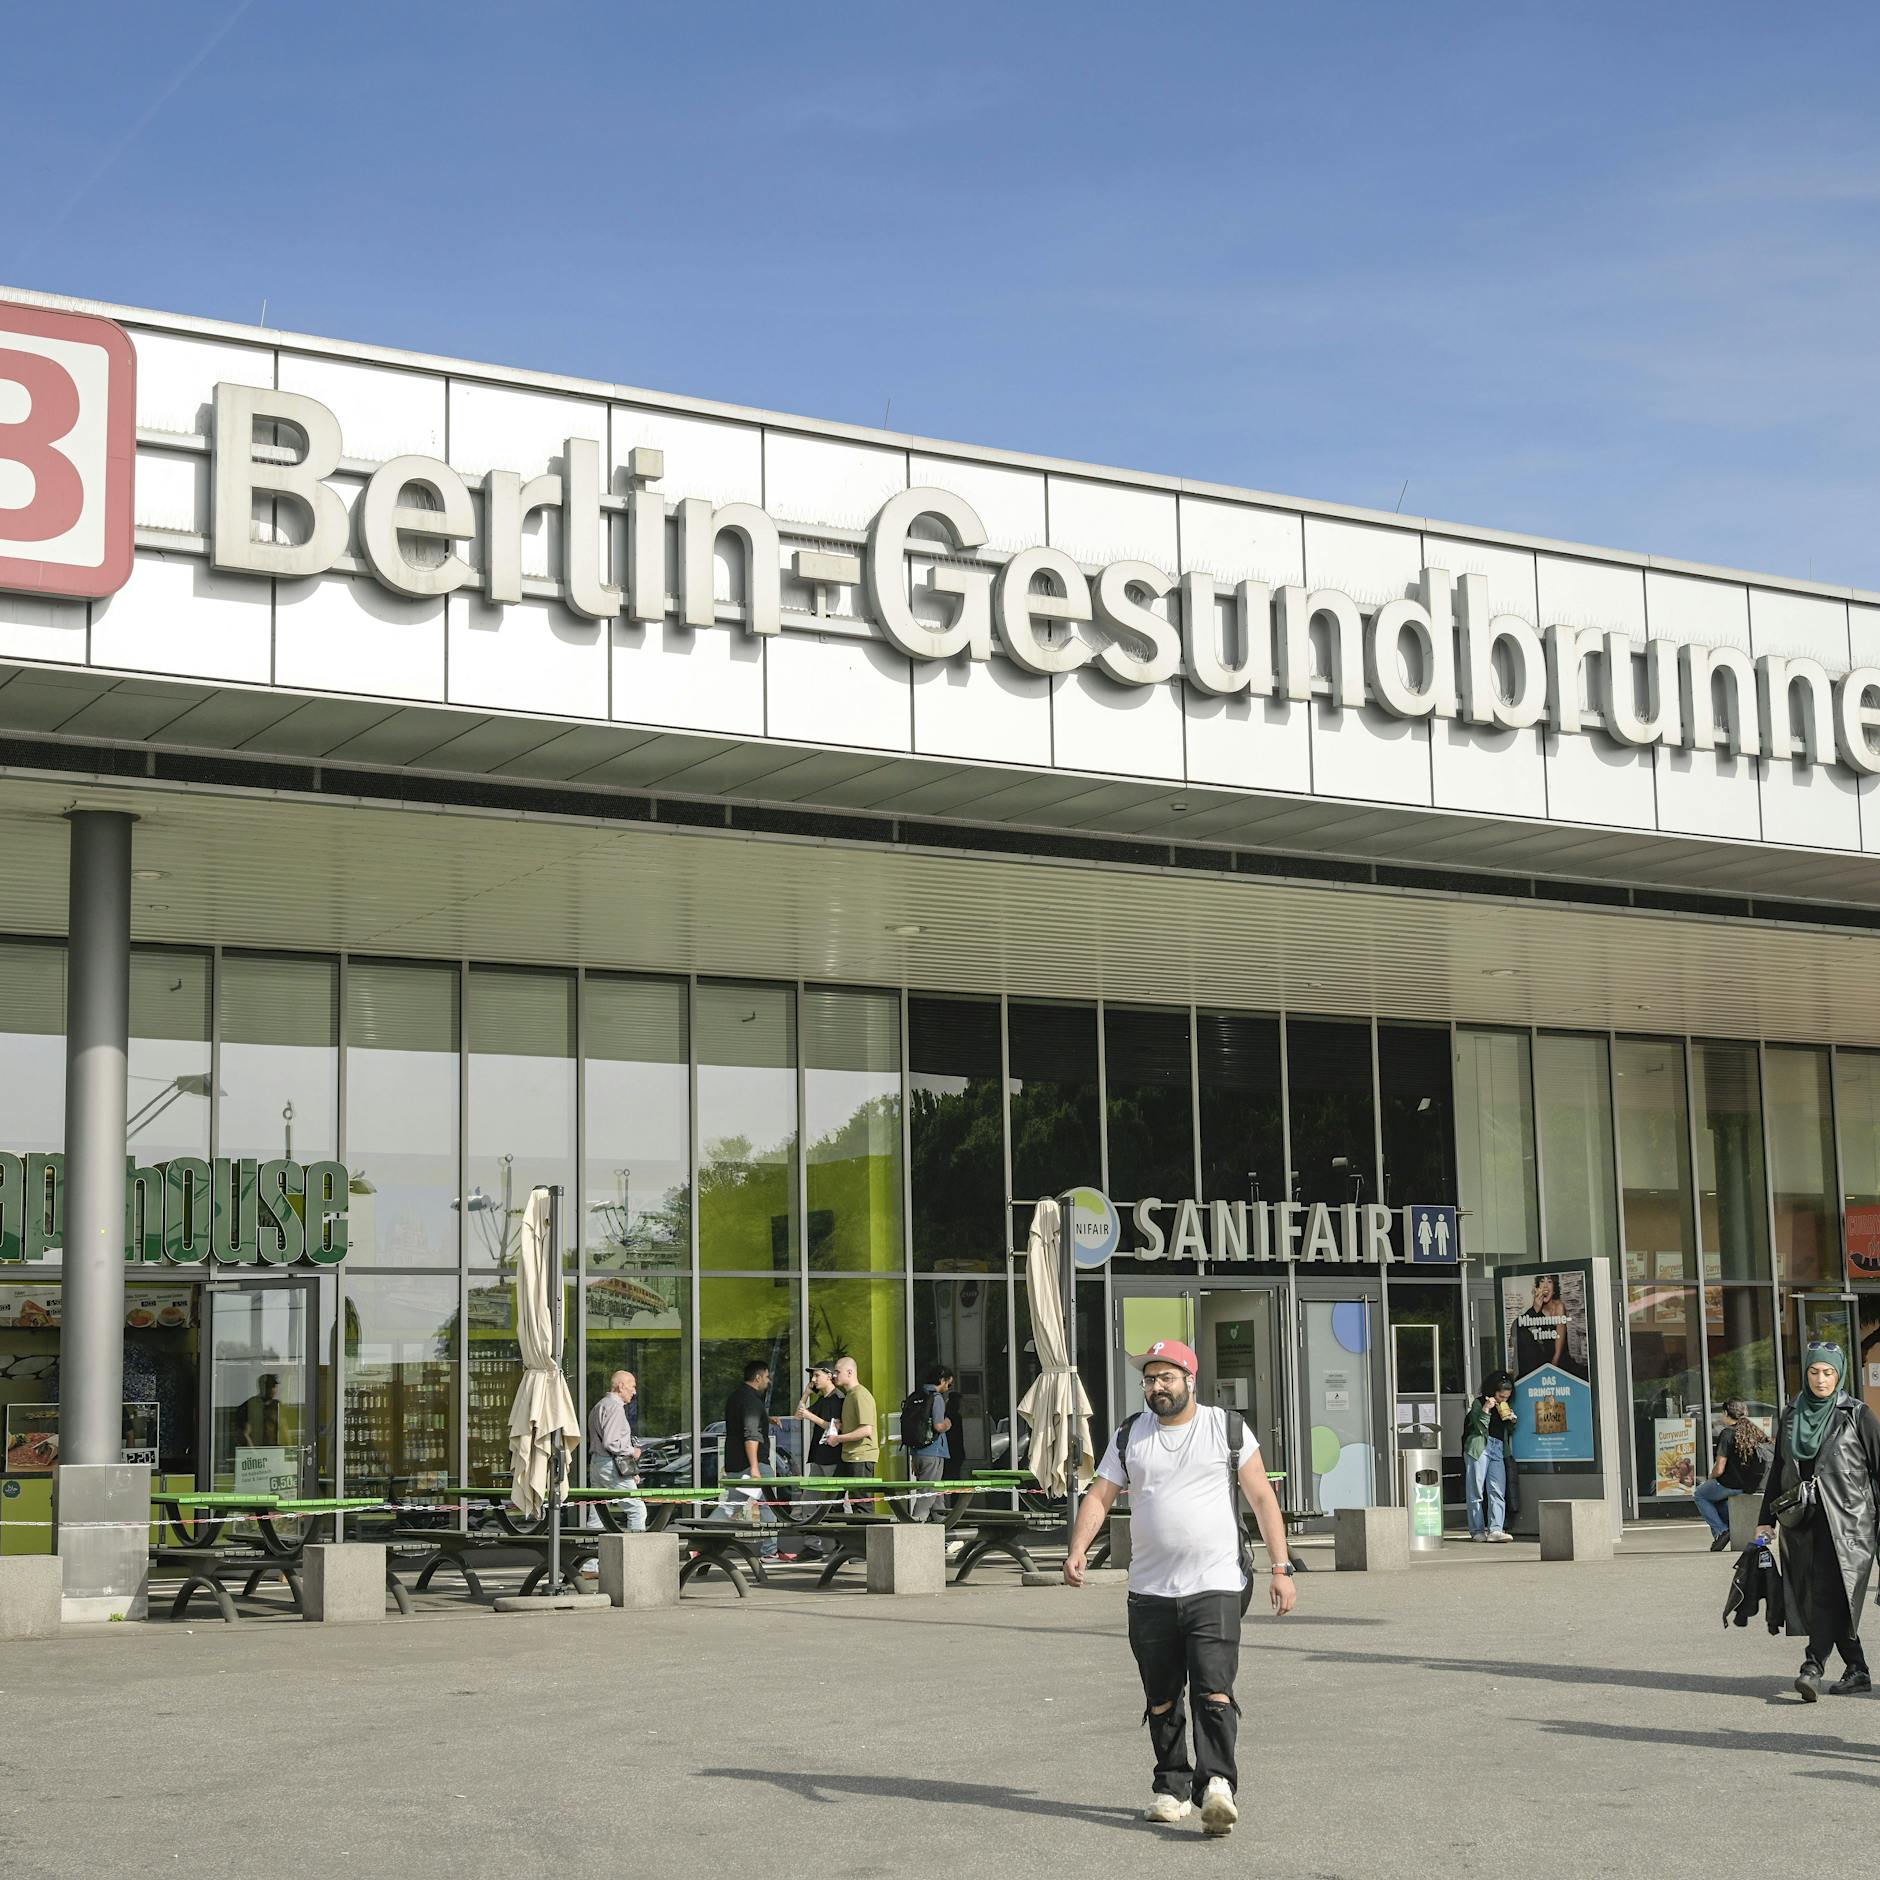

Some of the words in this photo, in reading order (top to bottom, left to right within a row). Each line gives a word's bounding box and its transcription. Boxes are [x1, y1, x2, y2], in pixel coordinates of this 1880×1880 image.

[126, 1155, 349, 1264] house
[1076, 1223, 1109, 1235] NIFAIR
[1133, 1197, 1395, 1264] SANIFAIR
[1532, 1327, 1560, 1340] Time.
[1153, 1342, 1165, 1355] P
[1541, 1376, 1557, 1387] DAS
[1528, 1387, 1555, 1398] BRINGT
[1556, 1386, 1571, 1397] NUR
[241, 1457, 268, 1471] döner
